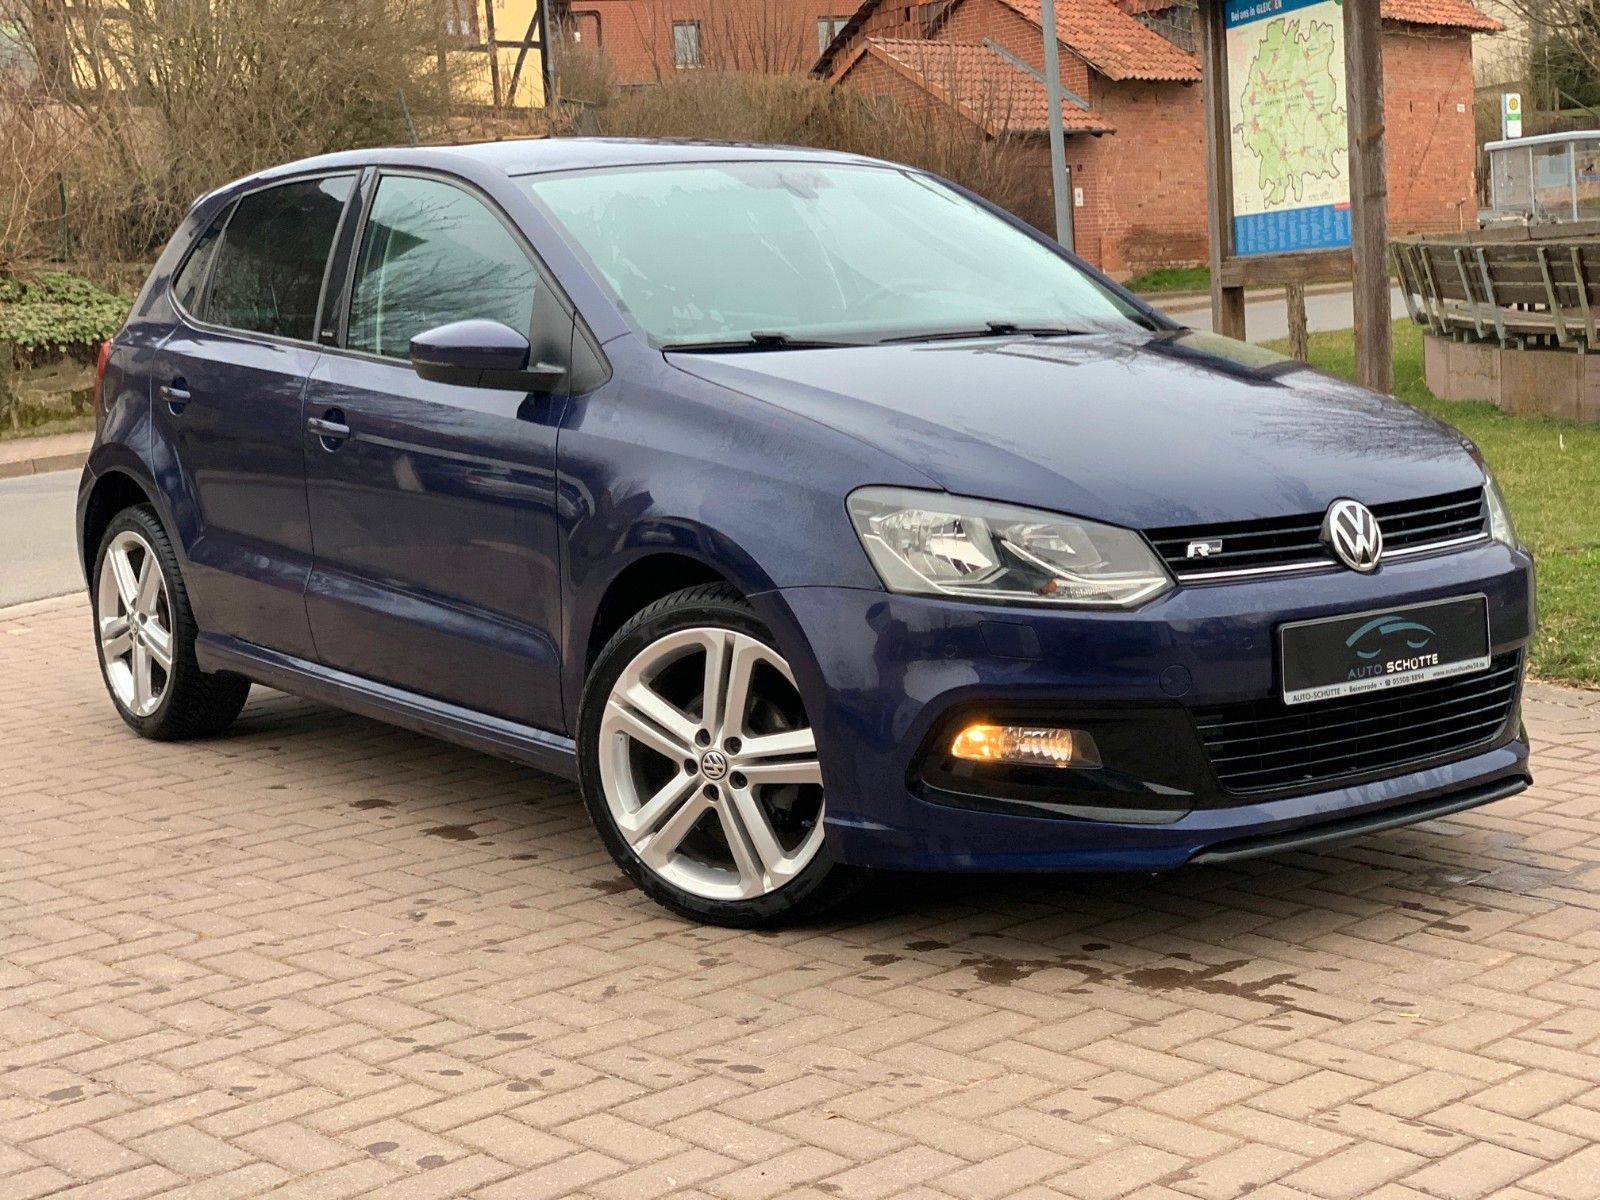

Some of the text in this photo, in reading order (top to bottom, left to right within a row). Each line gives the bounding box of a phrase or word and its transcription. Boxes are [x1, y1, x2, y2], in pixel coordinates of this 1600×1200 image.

[1240, 9, 1249, 19] uns
[1250, 6, 1255, 16] in
[1256, 0, 1282, 14] GLEICEN
[1329, 500, 1382, 571] VW
[1187, 543, 1209, 558] R
[1348, 653, 1438, 680] AUTO SCHÜTTE
[1293, 688, 1340, 702] AUTO-SCHÜTTE
